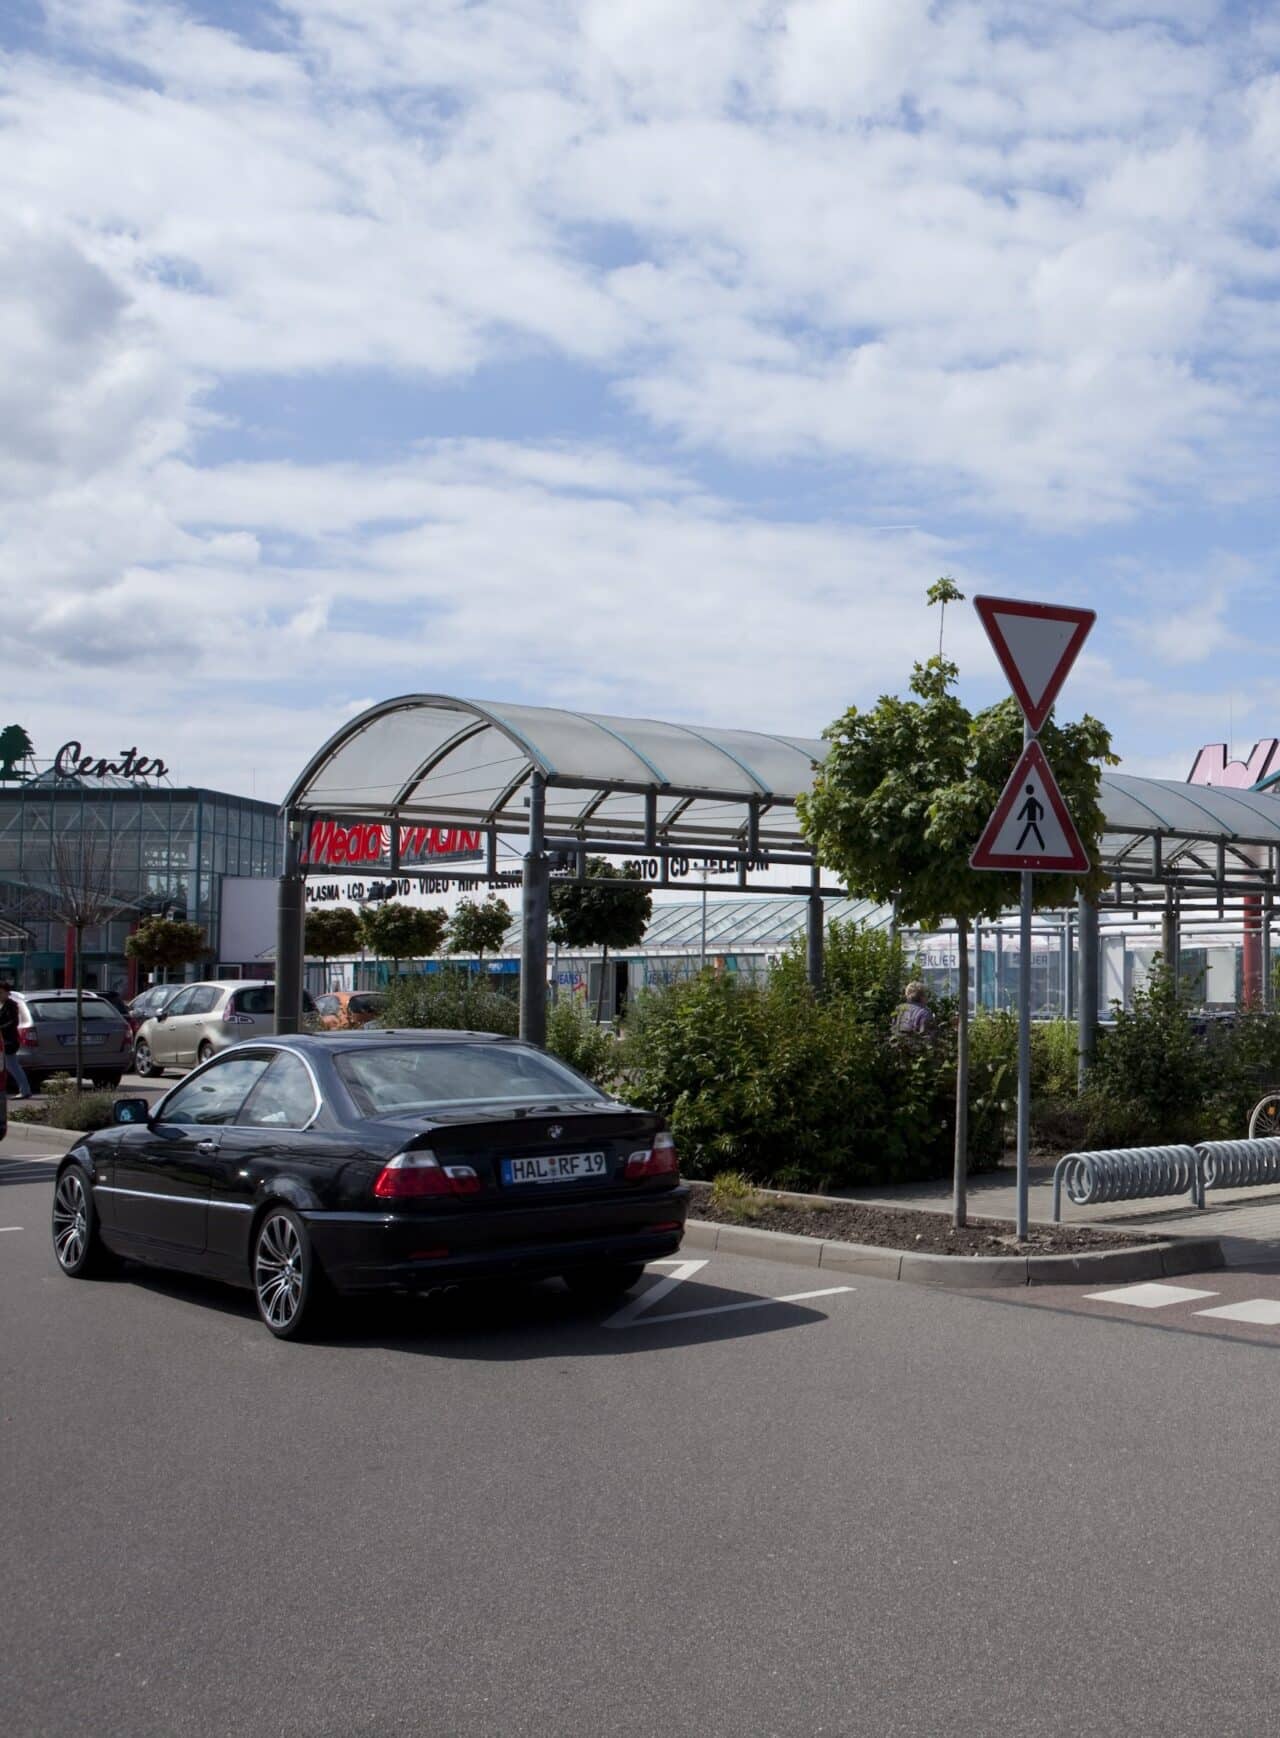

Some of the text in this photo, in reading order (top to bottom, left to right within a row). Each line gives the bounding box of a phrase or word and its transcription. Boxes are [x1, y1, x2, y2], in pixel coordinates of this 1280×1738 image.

[55, 741, 169, 779] Center
[305, 884, 341, 902] PLASMA
[347, 882, 365, 900] LCD
[418, 878, 450, 895] VIDEO
[670, 855, 689, 877] CD
[513, 1154, 604, 1180] HAL RF 19
